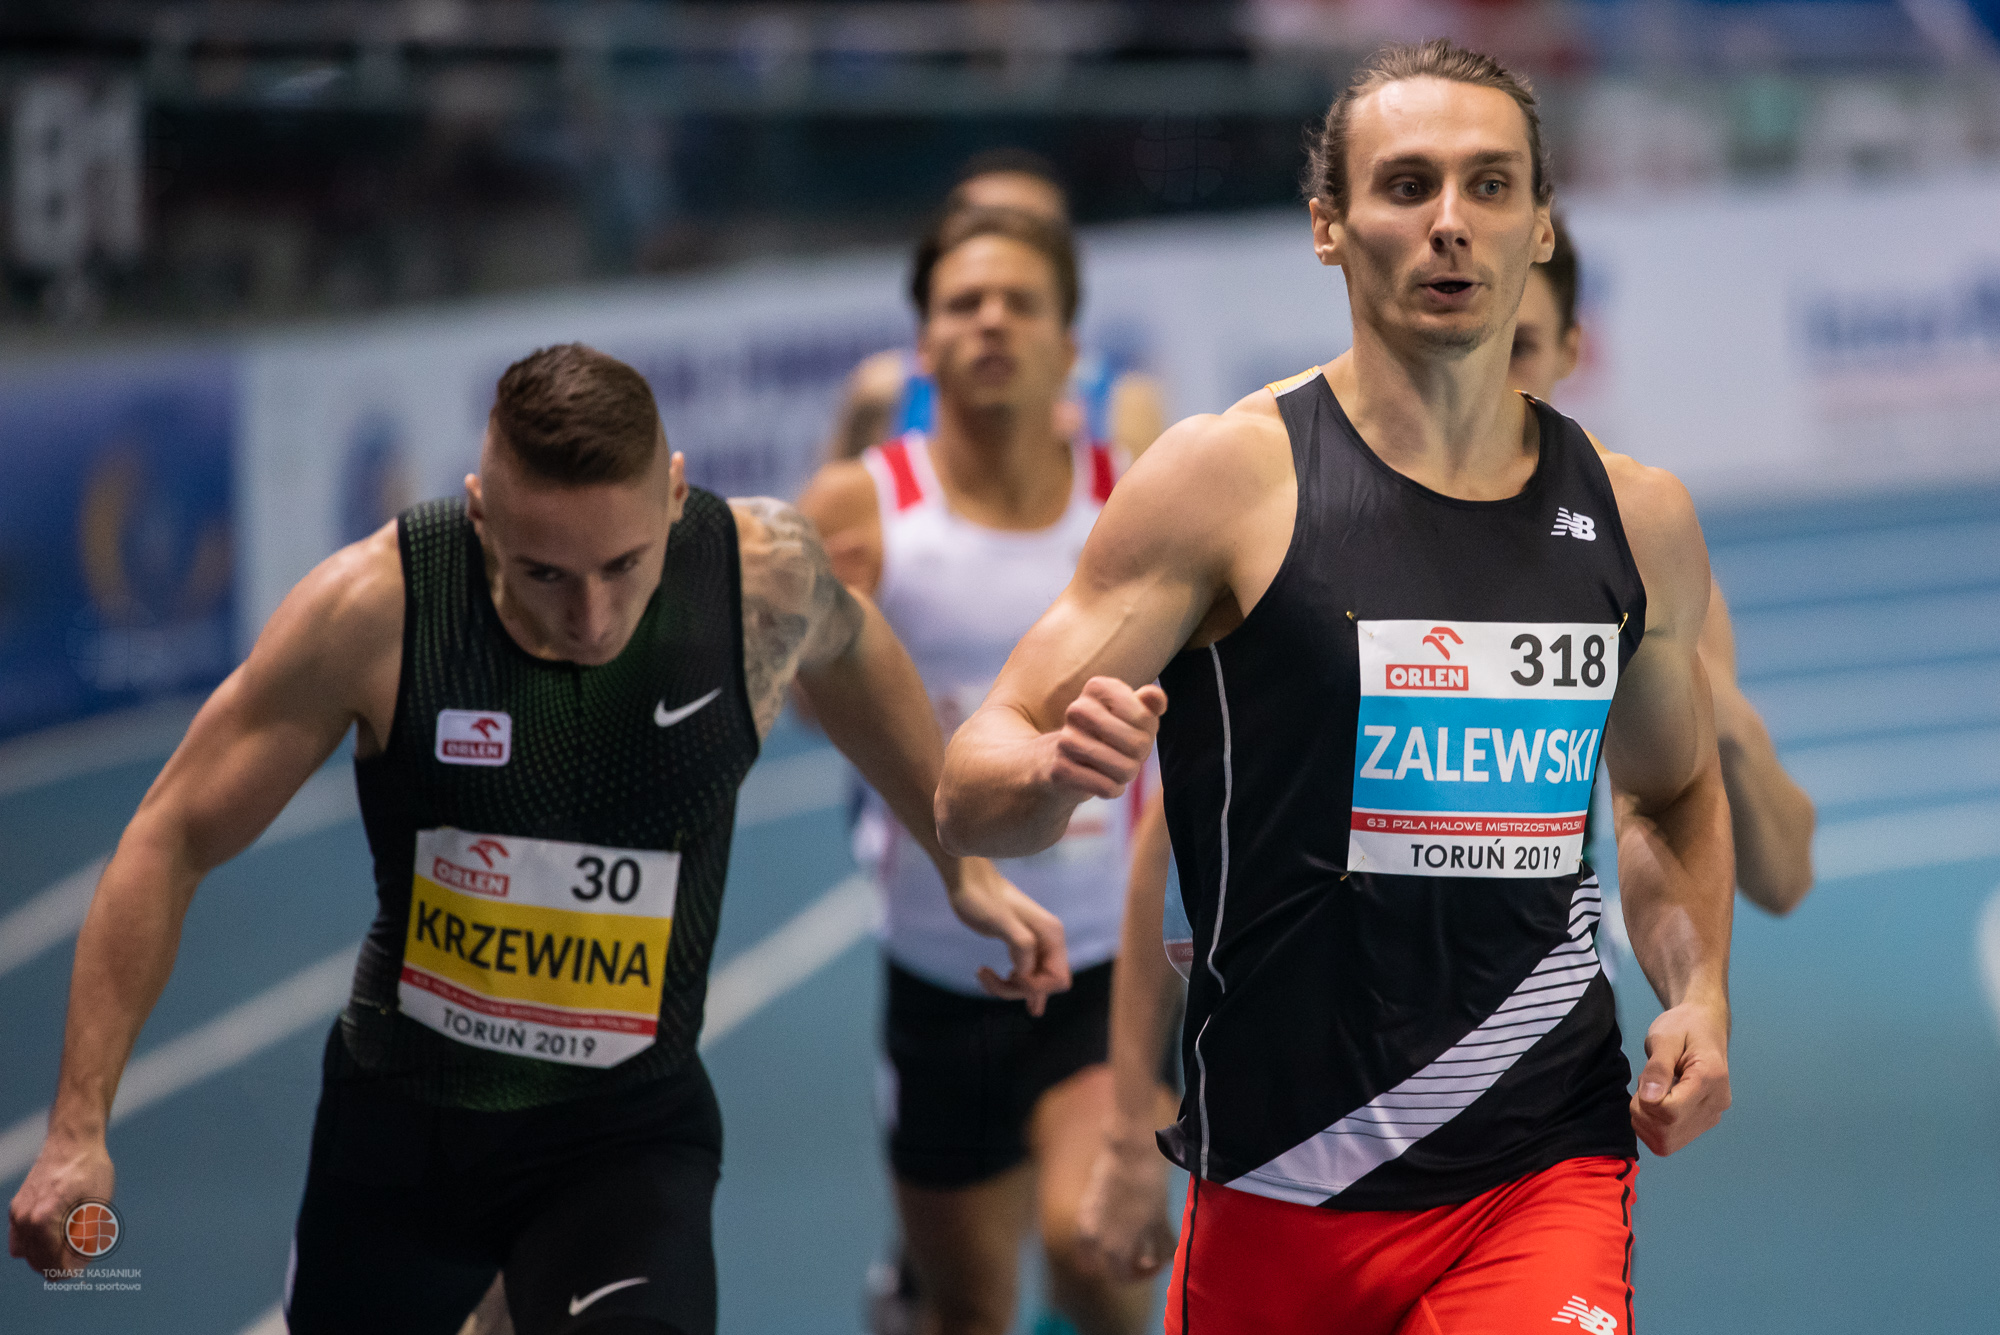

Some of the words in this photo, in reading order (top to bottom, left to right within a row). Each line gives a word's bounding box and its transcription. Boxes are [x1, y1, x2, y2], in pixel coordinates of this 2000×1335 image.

[1510, 633, 1607, 687] 318
[1389, 667, 1464, 688] ORLEN
[1359, 725, 1600, 784] ZALEWSKI
[1366, 817, 1390, 829] 63.
[1393, 819, 1428, 830] PZLA
[1430, 820, 1483, 832] HALOWE
[1485, 821, 1561, 833] MISTRZOSTWA
[1411, 838, 1505, 869] TORUŃ
[1514, 845, 1561, 870] 2019
[437, 862, 505, 894] ORLEN
[571, 856, 641, 904] 30
[416, 901, 652, 988] KRZEWINA
[534, 1031, 597, 1058] 2019
